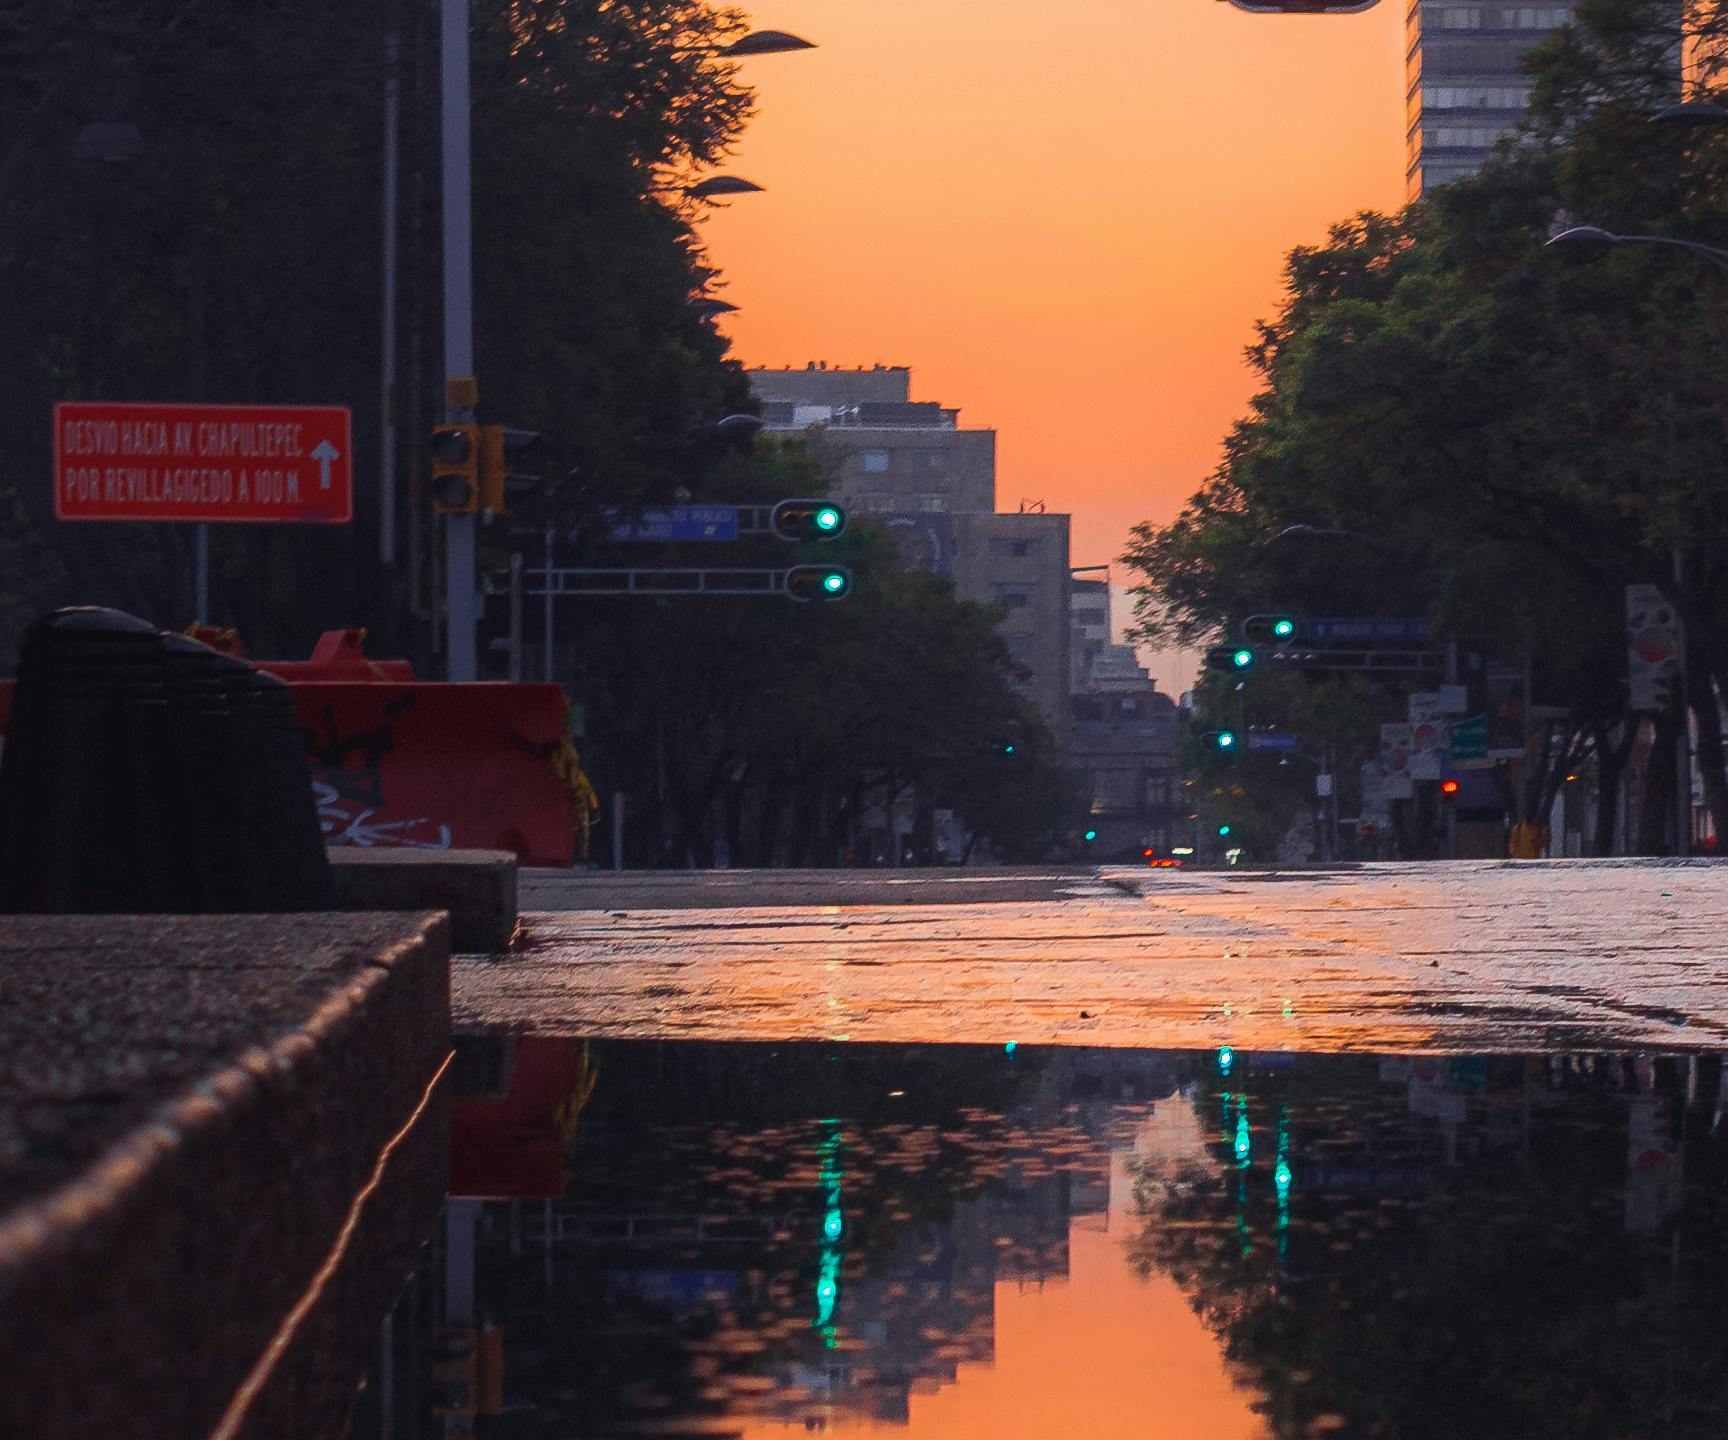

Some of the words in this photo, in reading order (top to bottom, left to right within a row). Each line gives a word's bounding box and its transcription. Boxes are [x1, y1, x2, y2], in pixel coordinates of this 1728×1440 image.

[121, 420, 168, 455] HACIA
[197, 422, 304, 458] CHAPULTEPEC
[65, 467, 99, 502] POR
[238, 468, 250, 503] A
[254, 470, 283, 504] 100
